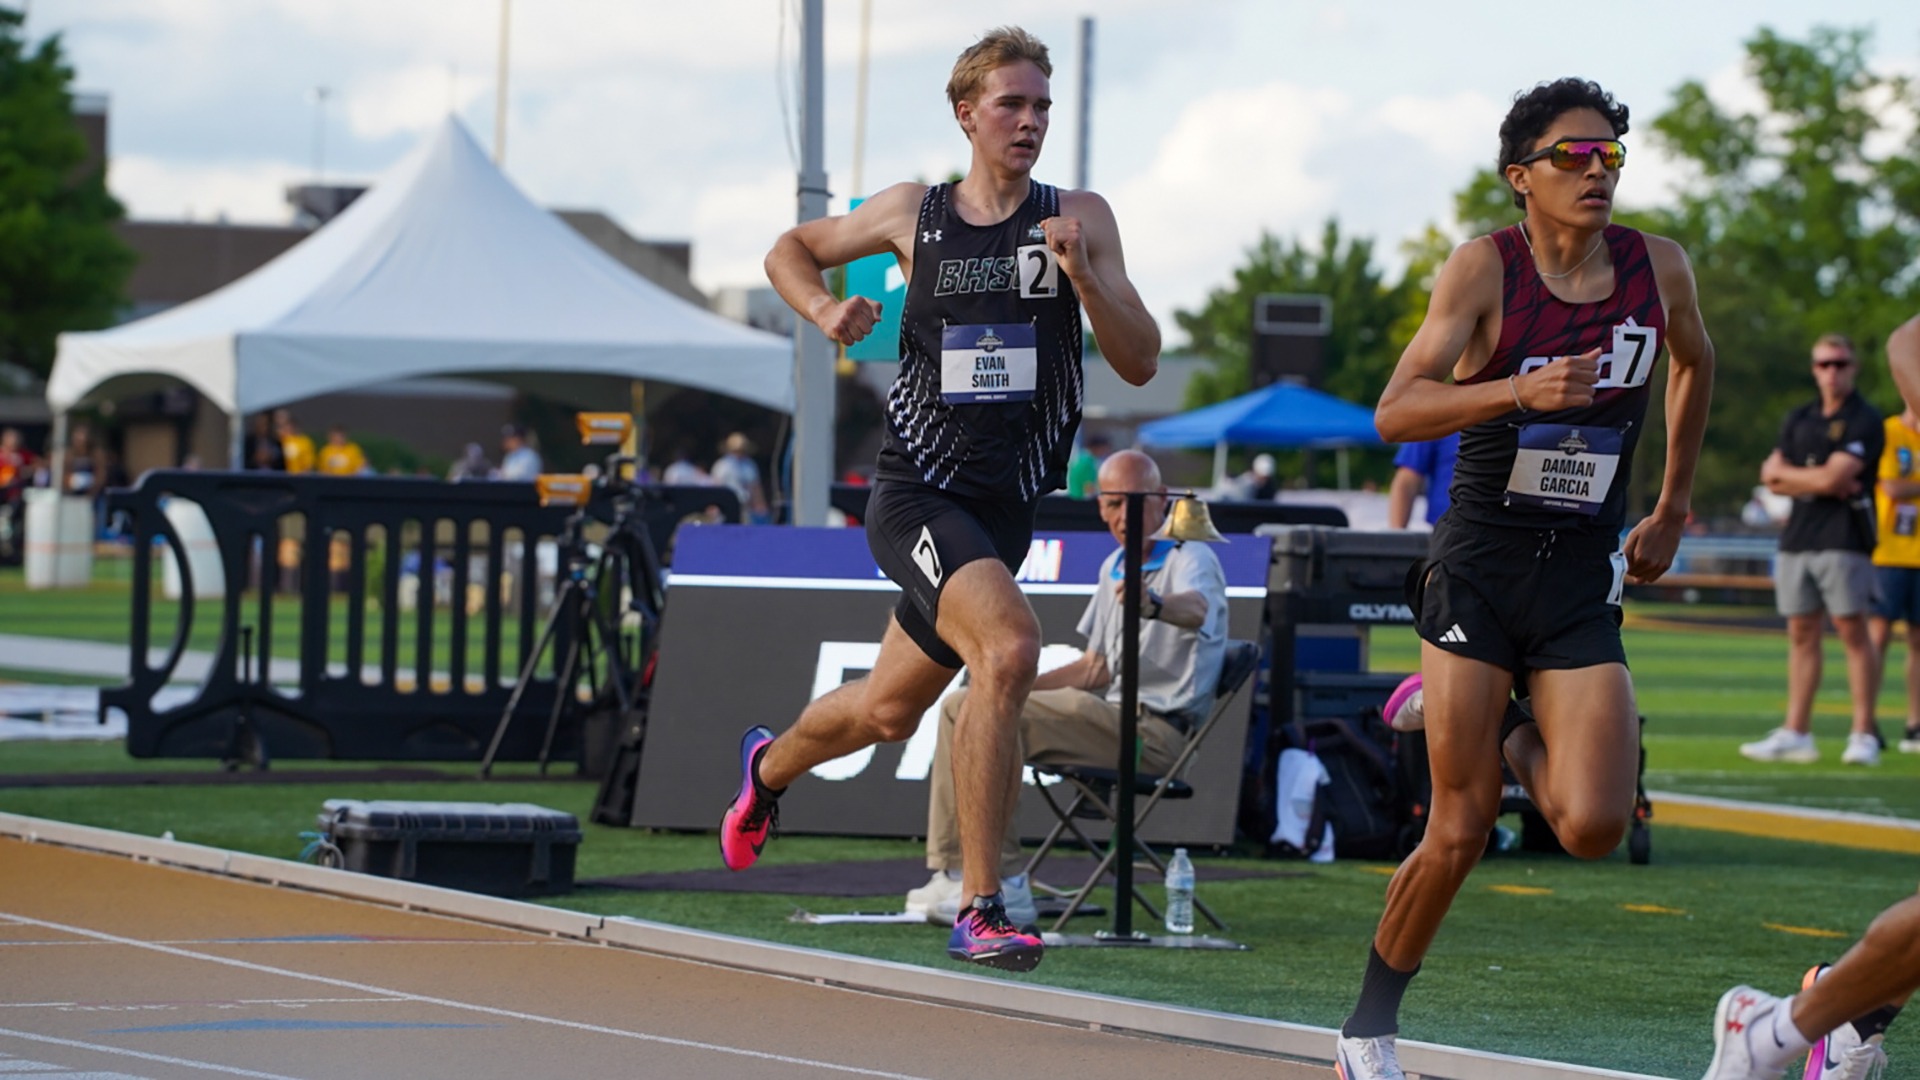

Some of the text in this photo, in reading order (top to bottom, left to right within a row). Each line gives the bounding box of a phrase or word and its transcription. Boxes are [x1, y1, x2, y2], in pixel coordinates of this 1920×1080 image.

[934, 256, 1021, 297] BHS
[1027, 250, 1049, 295] 2
[975, 356, 1005, 371] EVAN
[1623, 333, 1647, 384] 7
[972, 373, 1009, 388] SMITH
[1541, 458, 1596, 478] DAMIAN
[1540, 476, 1590, 497] GARCIA
